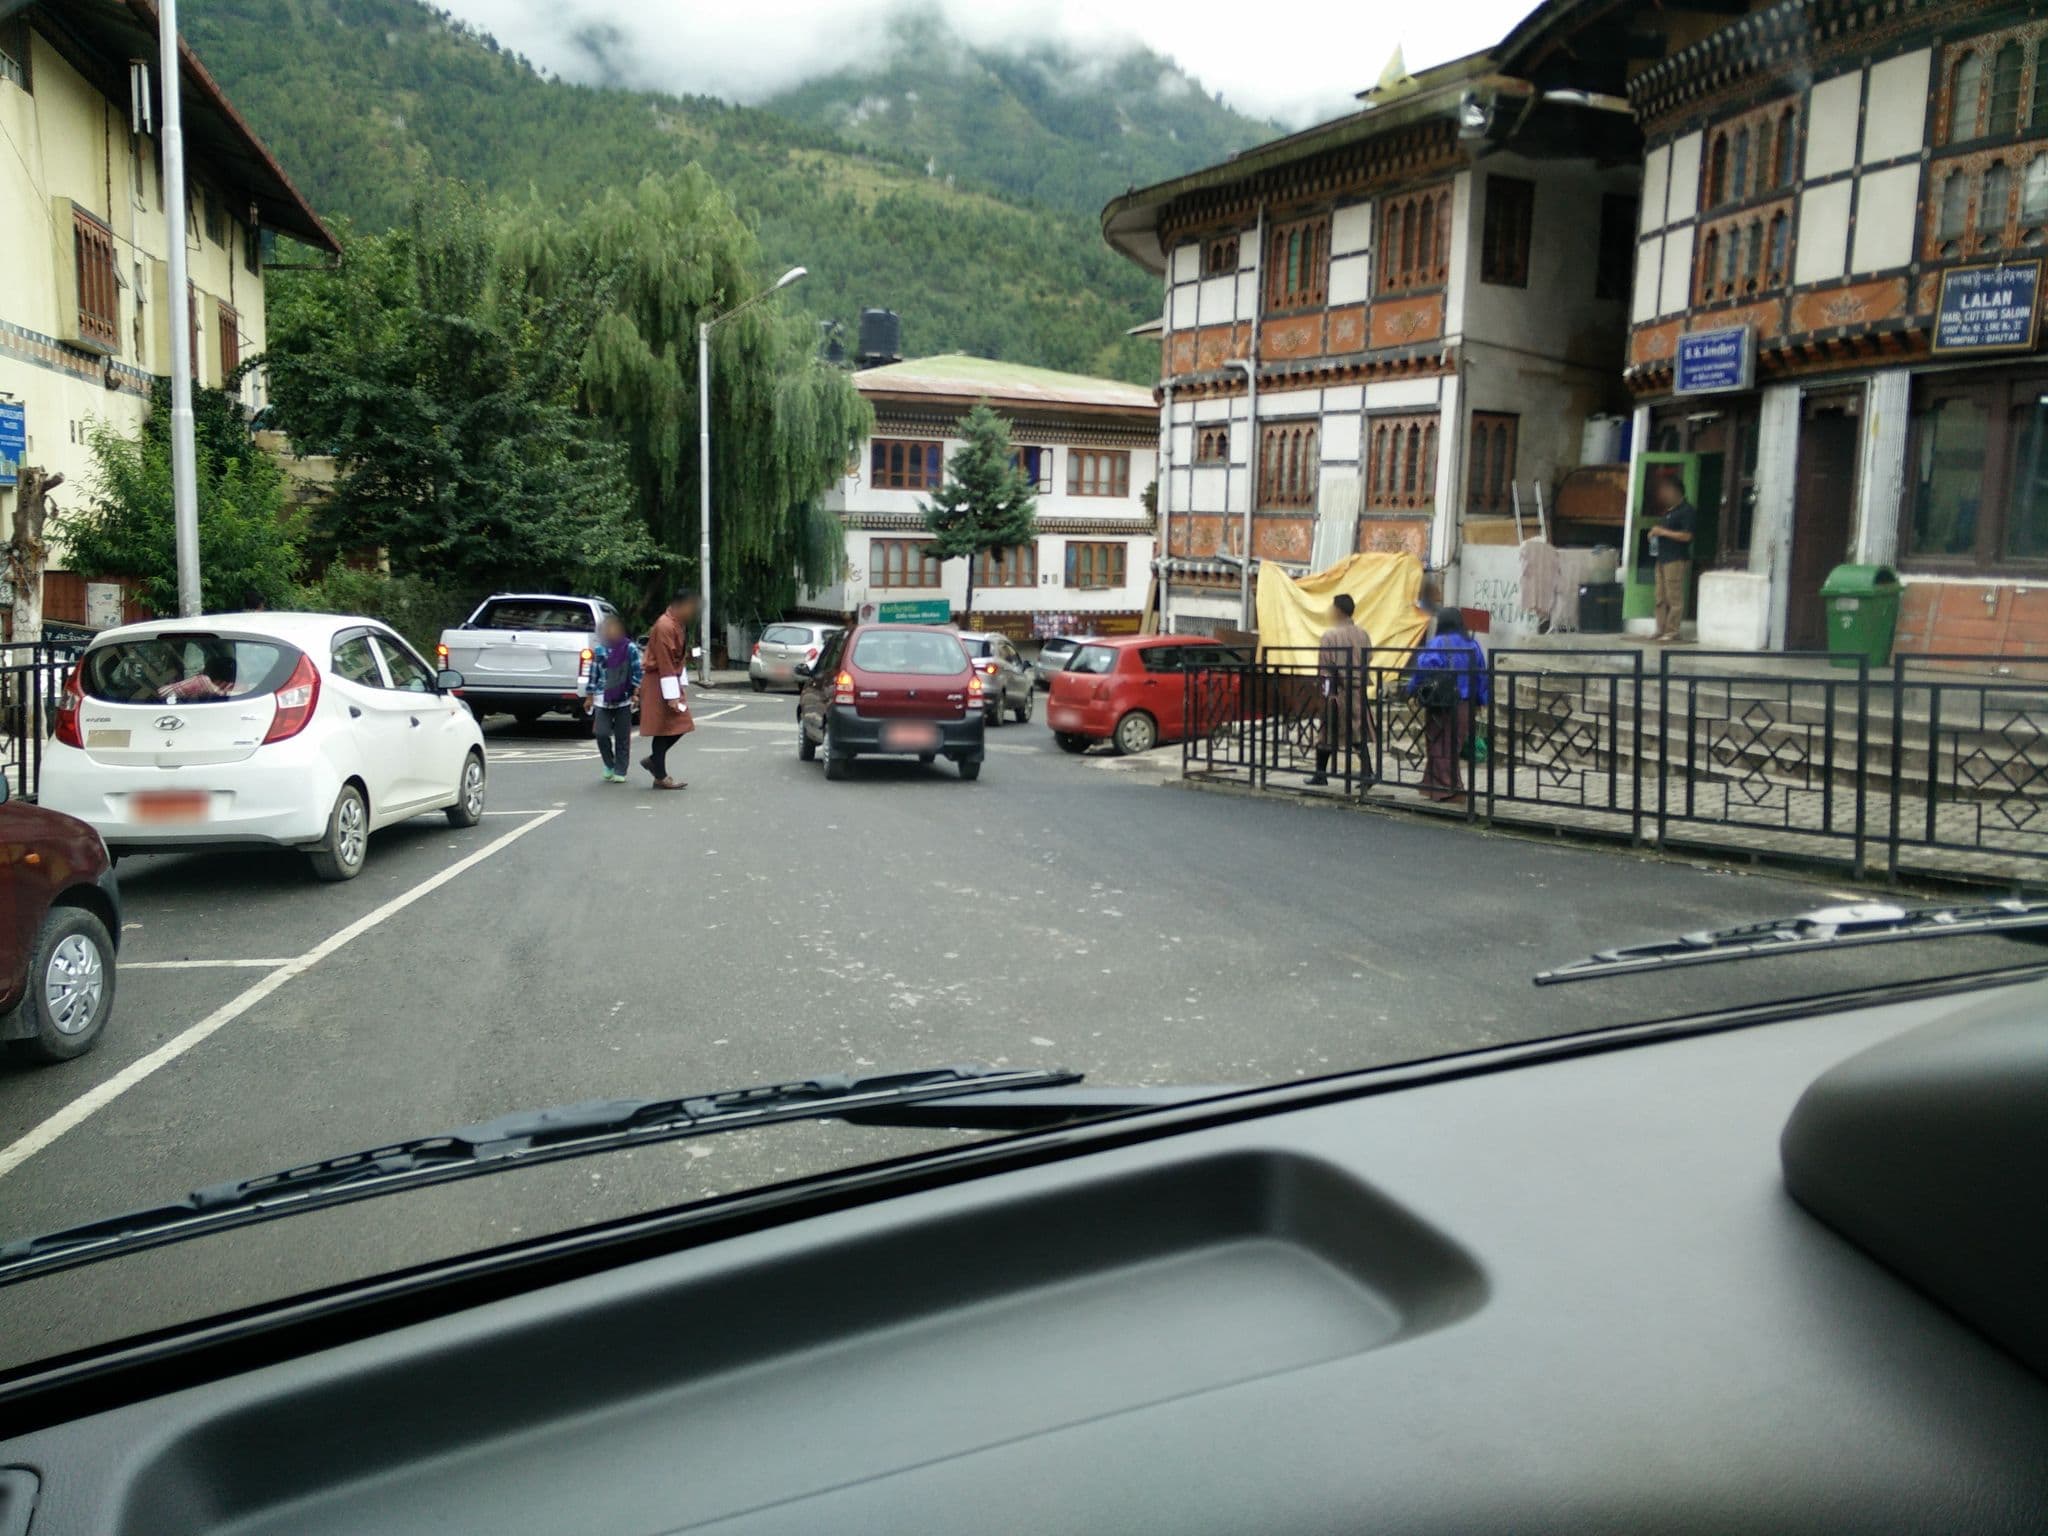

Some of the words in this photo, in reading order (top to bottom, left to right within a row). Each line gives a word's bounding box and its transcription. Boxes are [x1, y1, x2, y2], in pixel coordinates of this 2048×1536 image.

[1961, 291, 2012, 309] LALAN
[1964, 309, 1998, 322] CUTTING
[2000, 306, 2030, 320] SALOON
[1986, 333, 2020, 343] BHUTAN
[1473, 579, 1518, 600] PRIVA
[1473, 602, 1537, 625] RKIN
